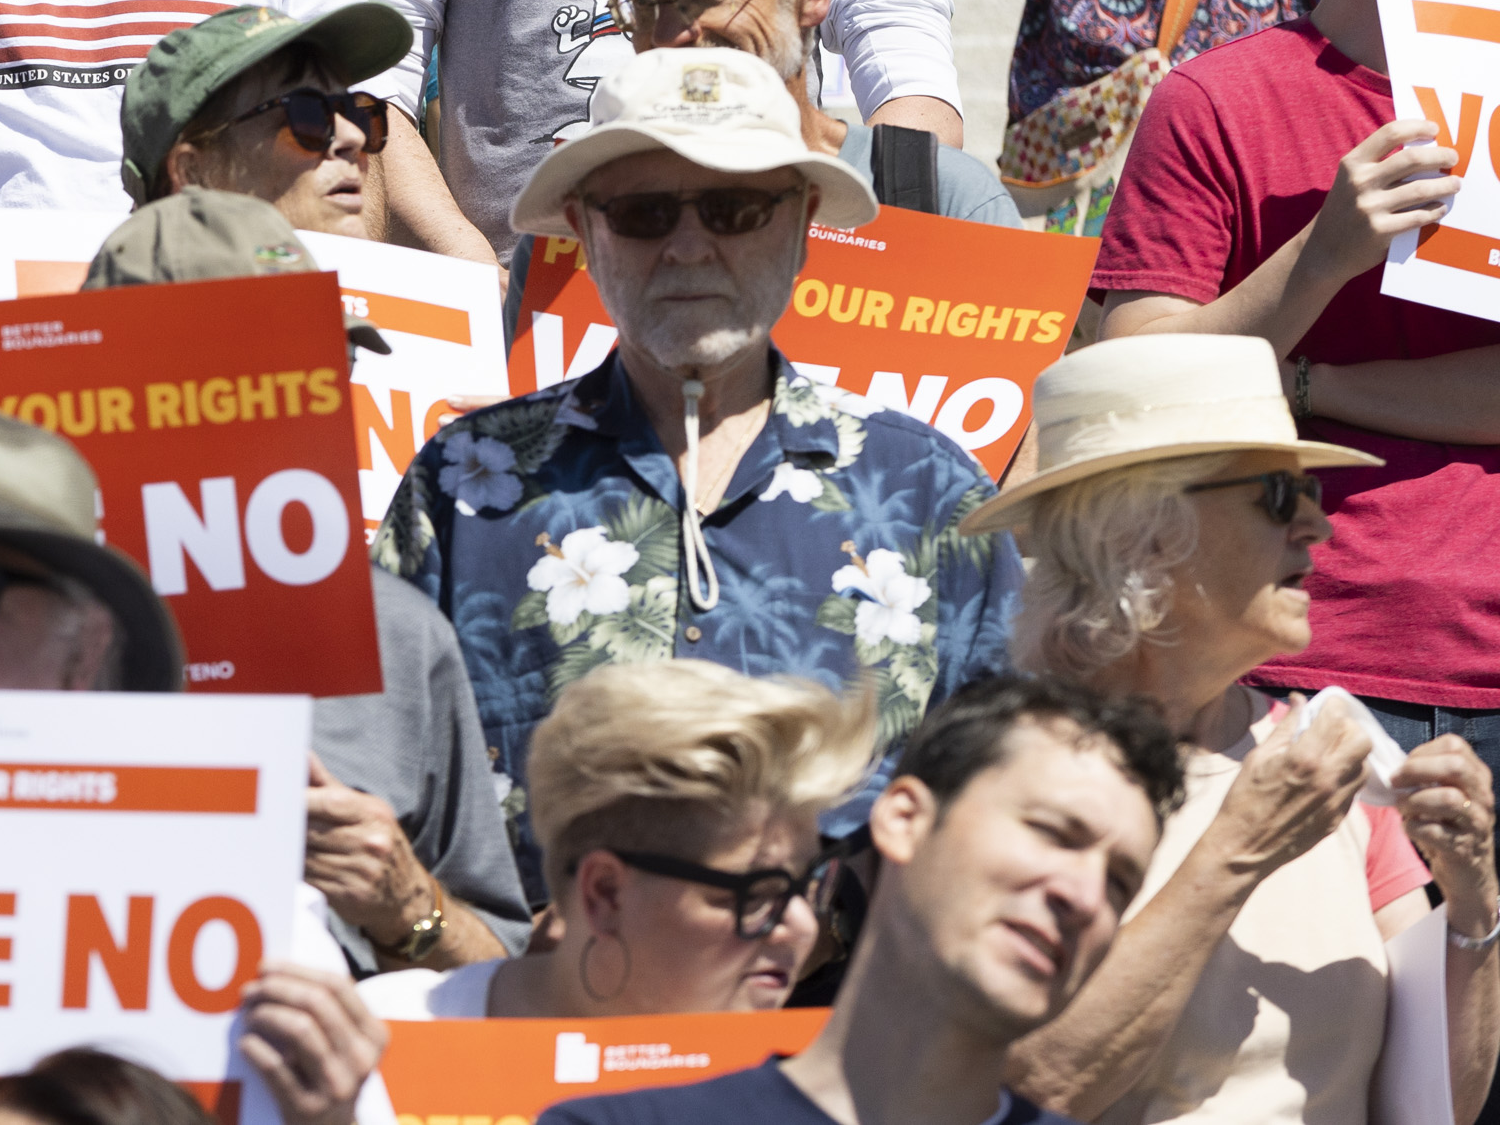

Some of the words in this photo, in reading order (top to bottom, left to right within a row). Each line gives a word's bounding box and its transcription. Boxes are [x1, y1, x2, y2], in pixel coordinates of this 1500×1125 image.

[52, 69, 110, 84] STATES
[808, 228, 887, 252] OUNDARIES
[792, 277, 895, 329] OUR
[900, 295, 1067, 344] RIGHTS
[1, 321, 64, 338] BETTER
[1, 330, 102, 352] BOUNDARIES
[146, 368, 343, 430] RIGHTS
[141, 467, 350, 596] NO
[14, 770, 116, 803] RIGHTS
[60, 894, 264, 1015] NO
